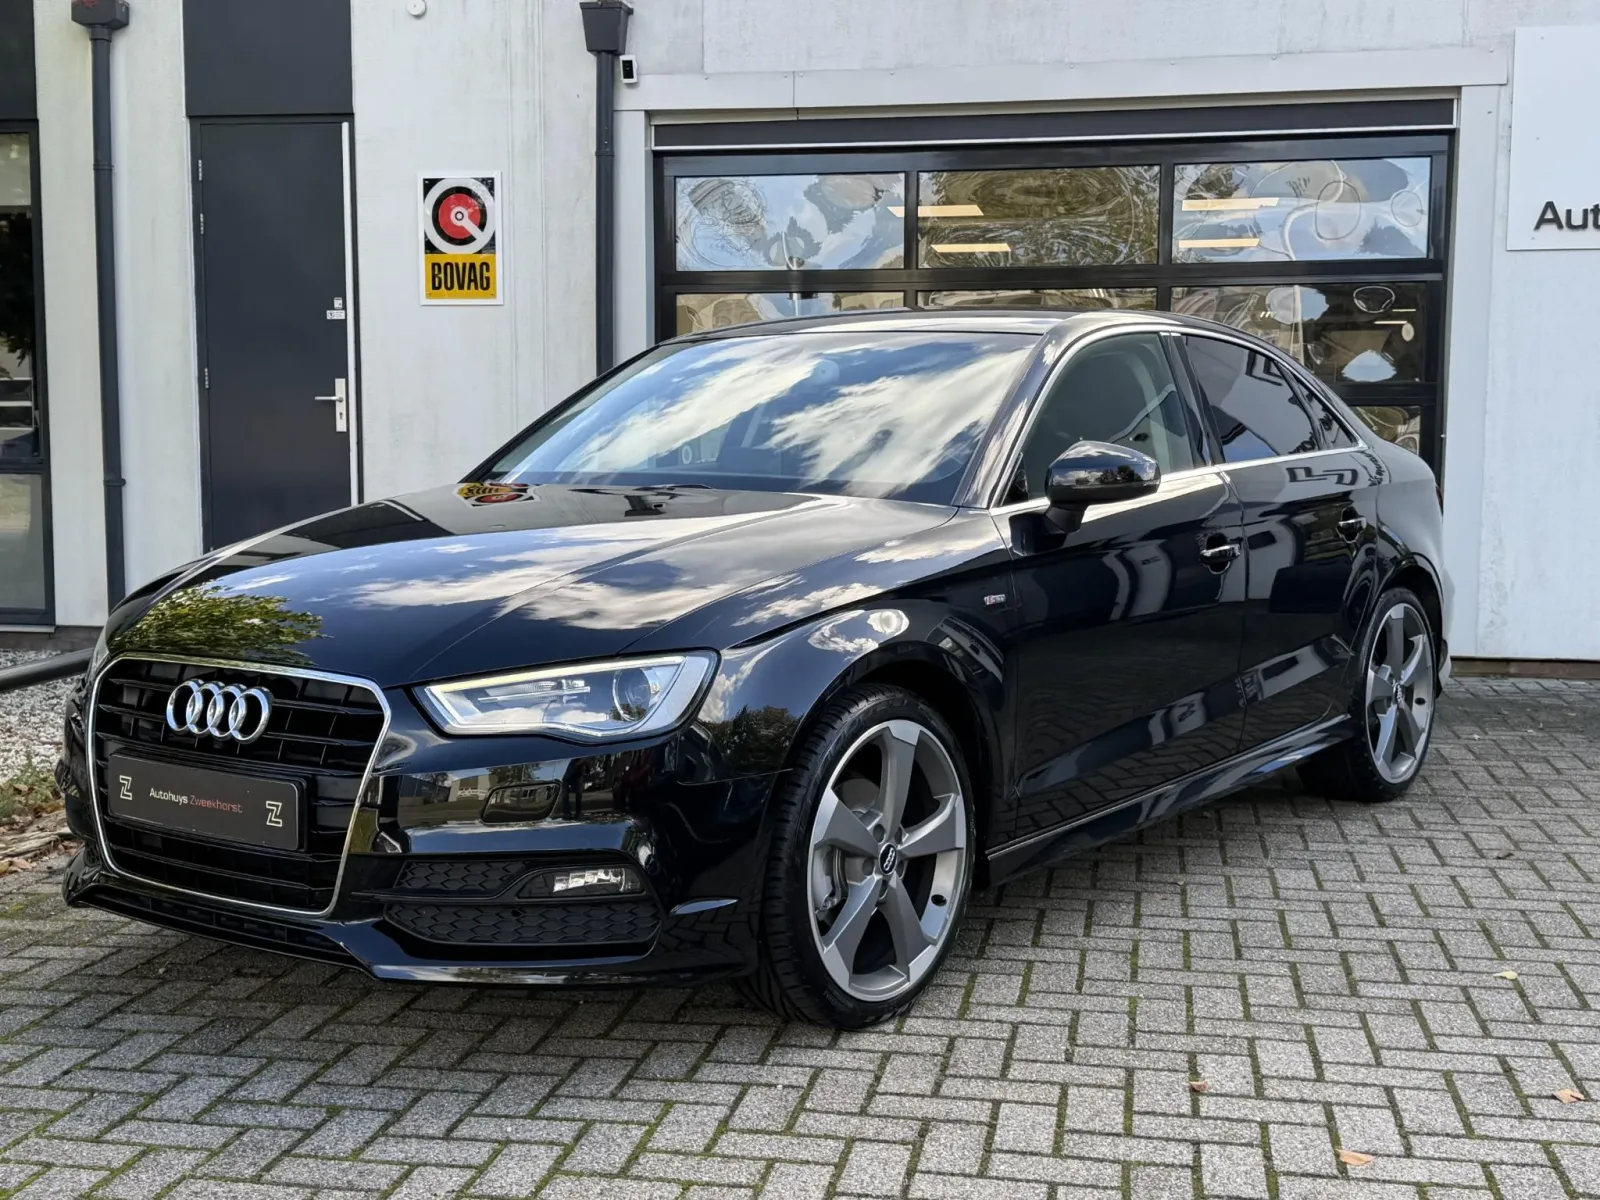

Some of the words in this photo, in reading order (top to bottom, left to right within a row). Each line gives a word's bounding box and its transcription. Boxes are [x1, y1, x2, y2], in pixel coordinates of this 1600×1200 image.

[1533, 200, 1600, 231] Aut
[431, 261, 490, 291] BOVAG
[149, 787, 189, 806] Autohuys
[189, 794, 243, 814] Zweekhorst
